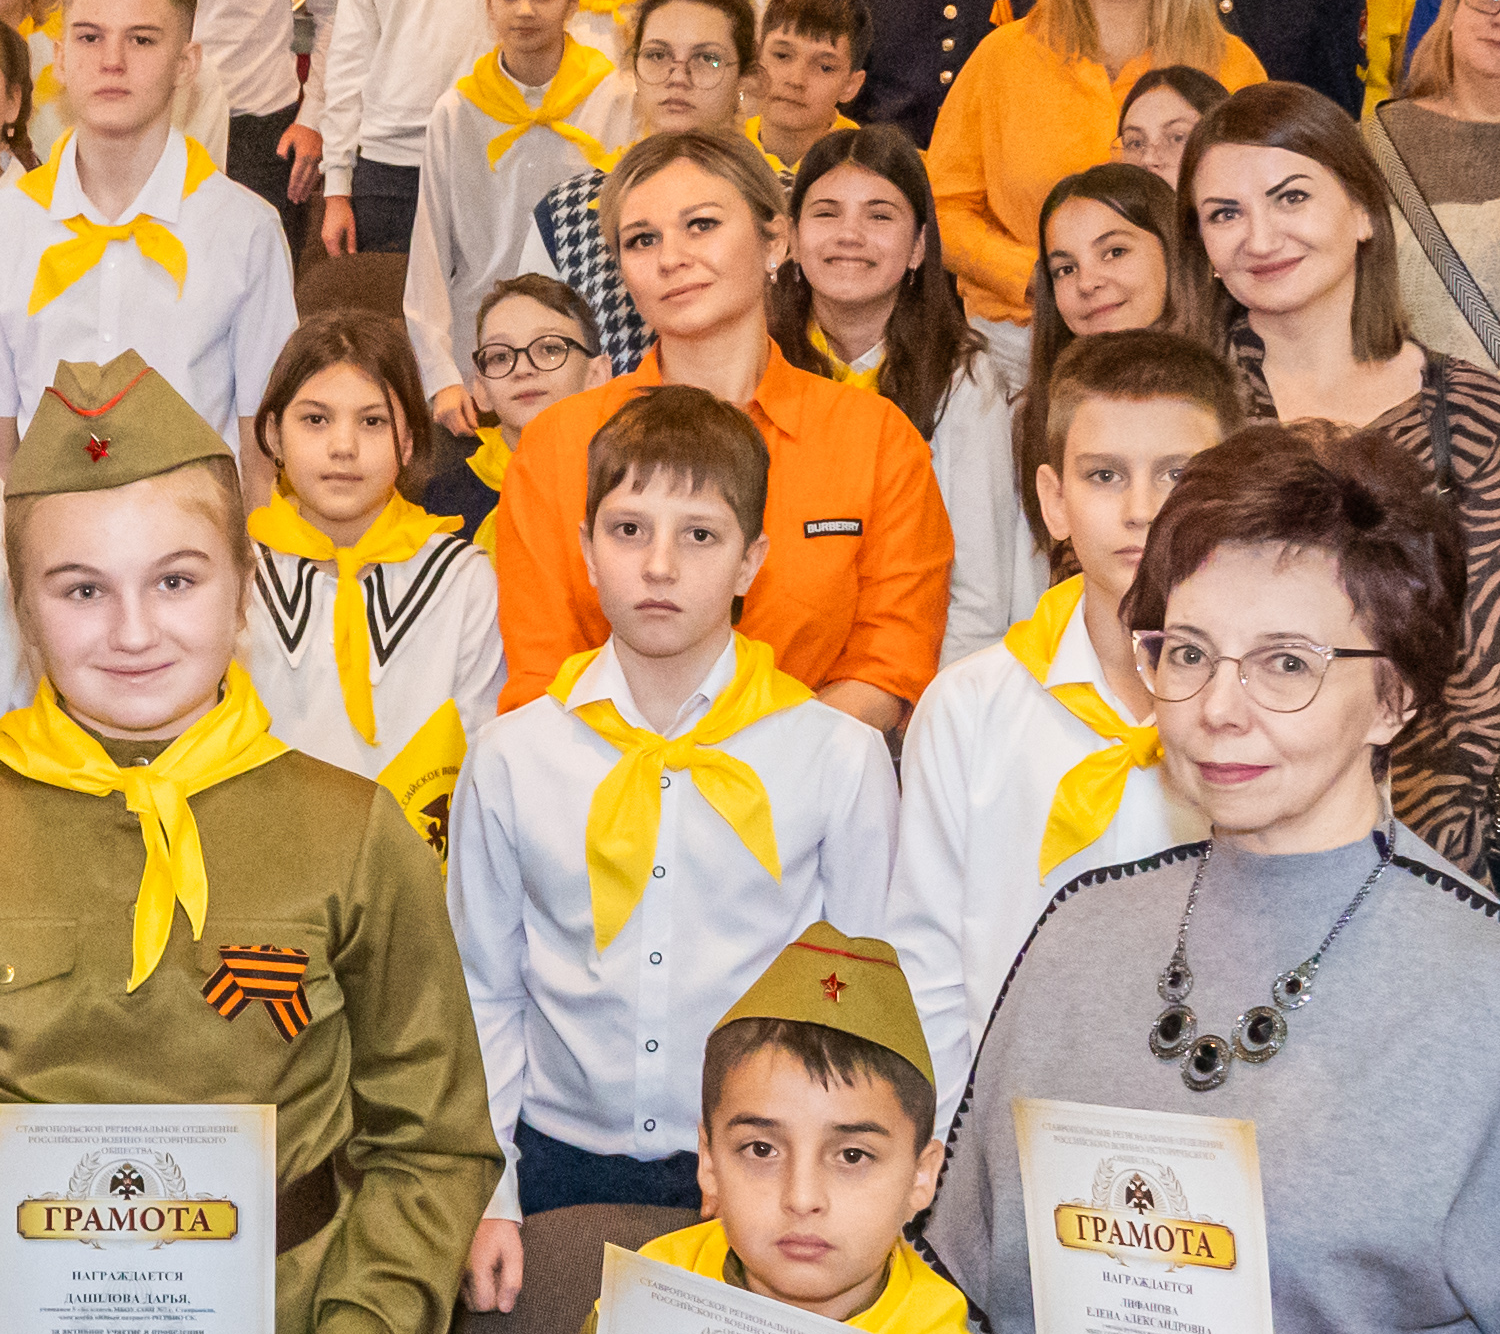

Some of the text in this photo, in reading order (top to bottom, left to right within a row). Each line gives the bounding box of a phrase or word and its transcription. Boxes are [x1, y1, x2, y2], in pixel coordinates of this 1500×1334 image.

[807, 521, 859, 533] BURBERRY
[28, 1135, 99, 1144] РОССИЙСКОГО
[101, 1147, 153, 1155] ОБЩЕСТВА
[44, 1207, 213, 1232] ГРАМОТА
[1075, 1214, 1215, 1259] ГРАМОТА
[72, 1271, 183, 1281] НАГРАЖДАЕТСЯ
[1102, 1271, 1193, 1295] НАГРАЖДАЕТСЯ
[64, 1294, 191, 1304] ДАНИЛОВА ДАРЬЯ,
[639, 1277, 727, 1312] СТАВРОПОЛЬСКОЕ
[651, 1292, 722, 1322] РОССИЙСКОГО
[1086, 1306, 1121, 1321] ЕЛЕНА
